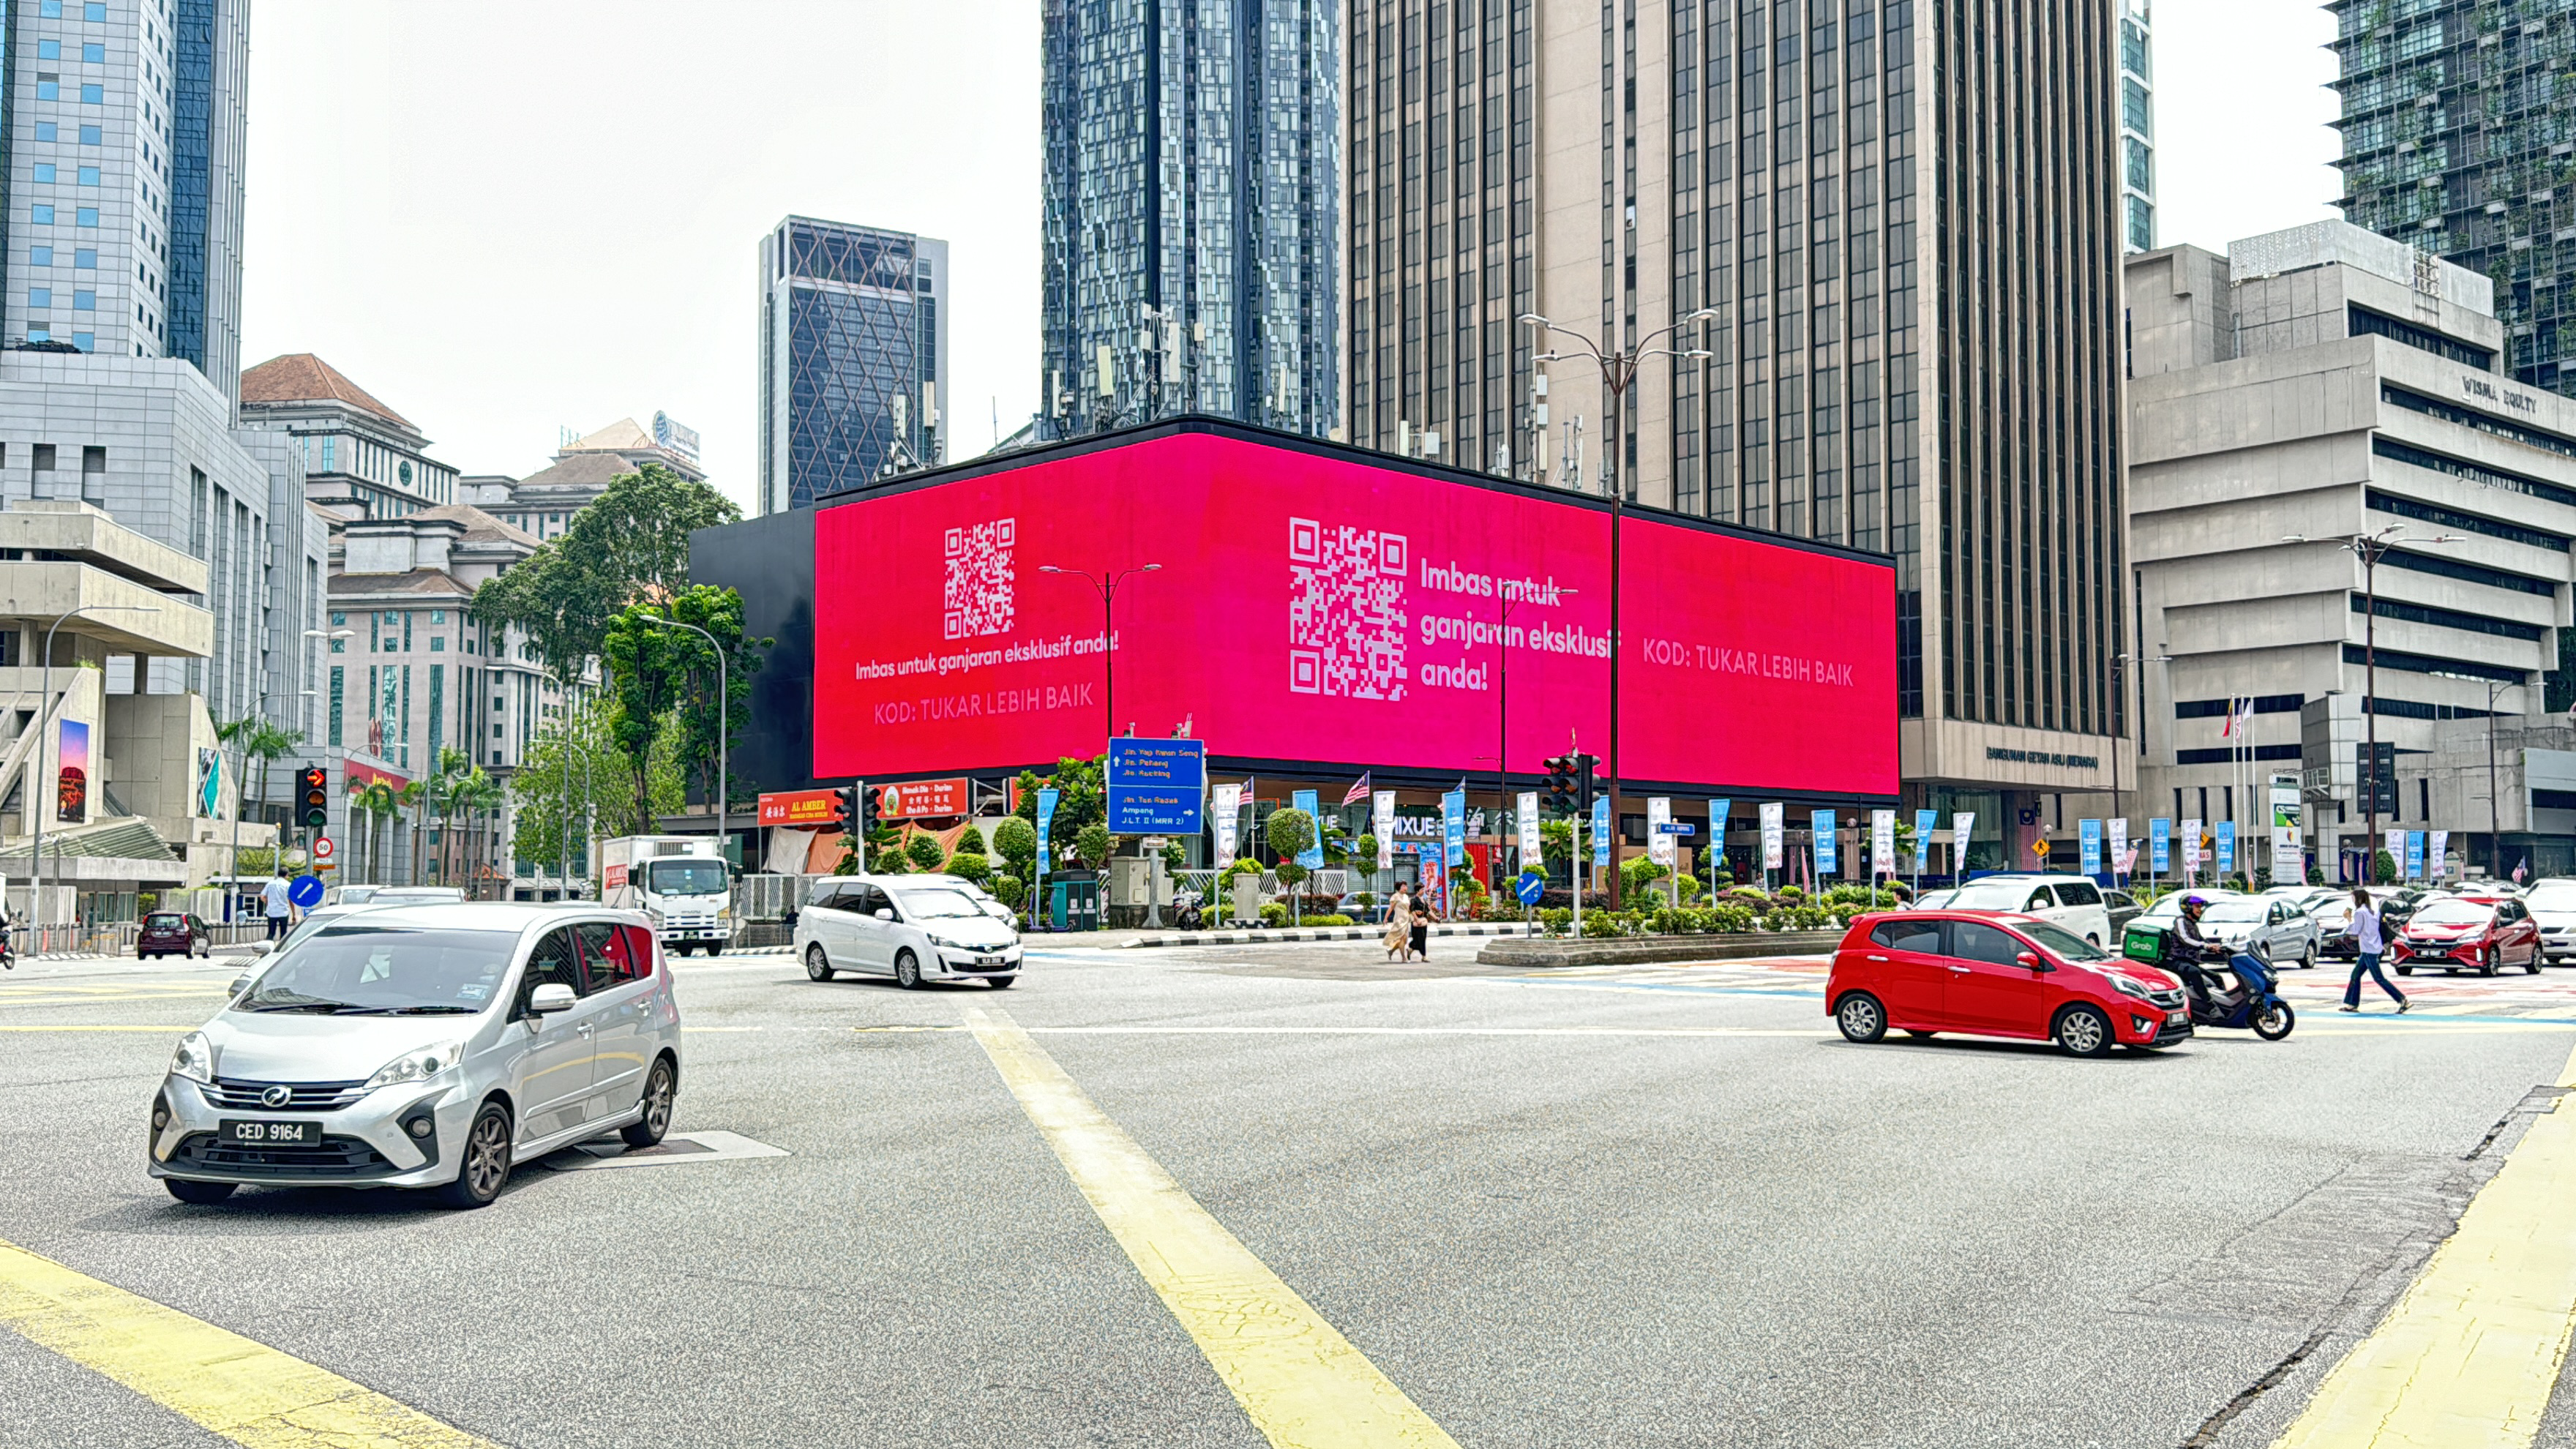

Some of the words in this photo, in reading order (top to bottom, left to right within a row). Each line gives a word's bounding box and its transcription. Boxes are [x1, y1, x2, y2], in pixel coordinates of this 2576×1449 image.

[2462, 375, 2498, 402] WISMA
[1420, 557, 1493, 597] Imbas
[1497, 575, 1561, 607] untuk
[1420, 610, 1524, 650] ganjaran
[1529, 621, 1621, 659] eksklusi
[855, 660, 895, 680] Imbas
[897, 652, 937, 675] untuk
[939, 648, 1002, 675] ganjaran
[1005, 634, 1072, 664] eksklusif
[1643, 637, 1690, 667] KOD:
[1696, 644, 1759, 676] TUKAR
[1762, 654, 1811, 682] LEBIH
[1815, 660, 1854, 687] BAIK
[1420, 657, 1488, 691] anda!
[875, 702, 916, 724] KOD:
[921, 694, 981, 721] TUKAR
[987, 688, 1040, 714] LEBIH
[1046, 682, 1095, 710] BAIK
[1986, 746, 2026, 762] BANGUNAN
[2027, 751, 2049, 765] GETAH
[2051, 753, 2065, 766] ASLI
[791, 801, 801, 812] AL
[801, 800, 826, 811] AMBER
[1122, 806, 1154, 815] Ampang
[1176, 817, 1184, 825] 2)
[2130, 941, 2152, 951] Grab
[236, 1123, 264, 1139] CED
[269, 1124, 303, 1140] 9164
